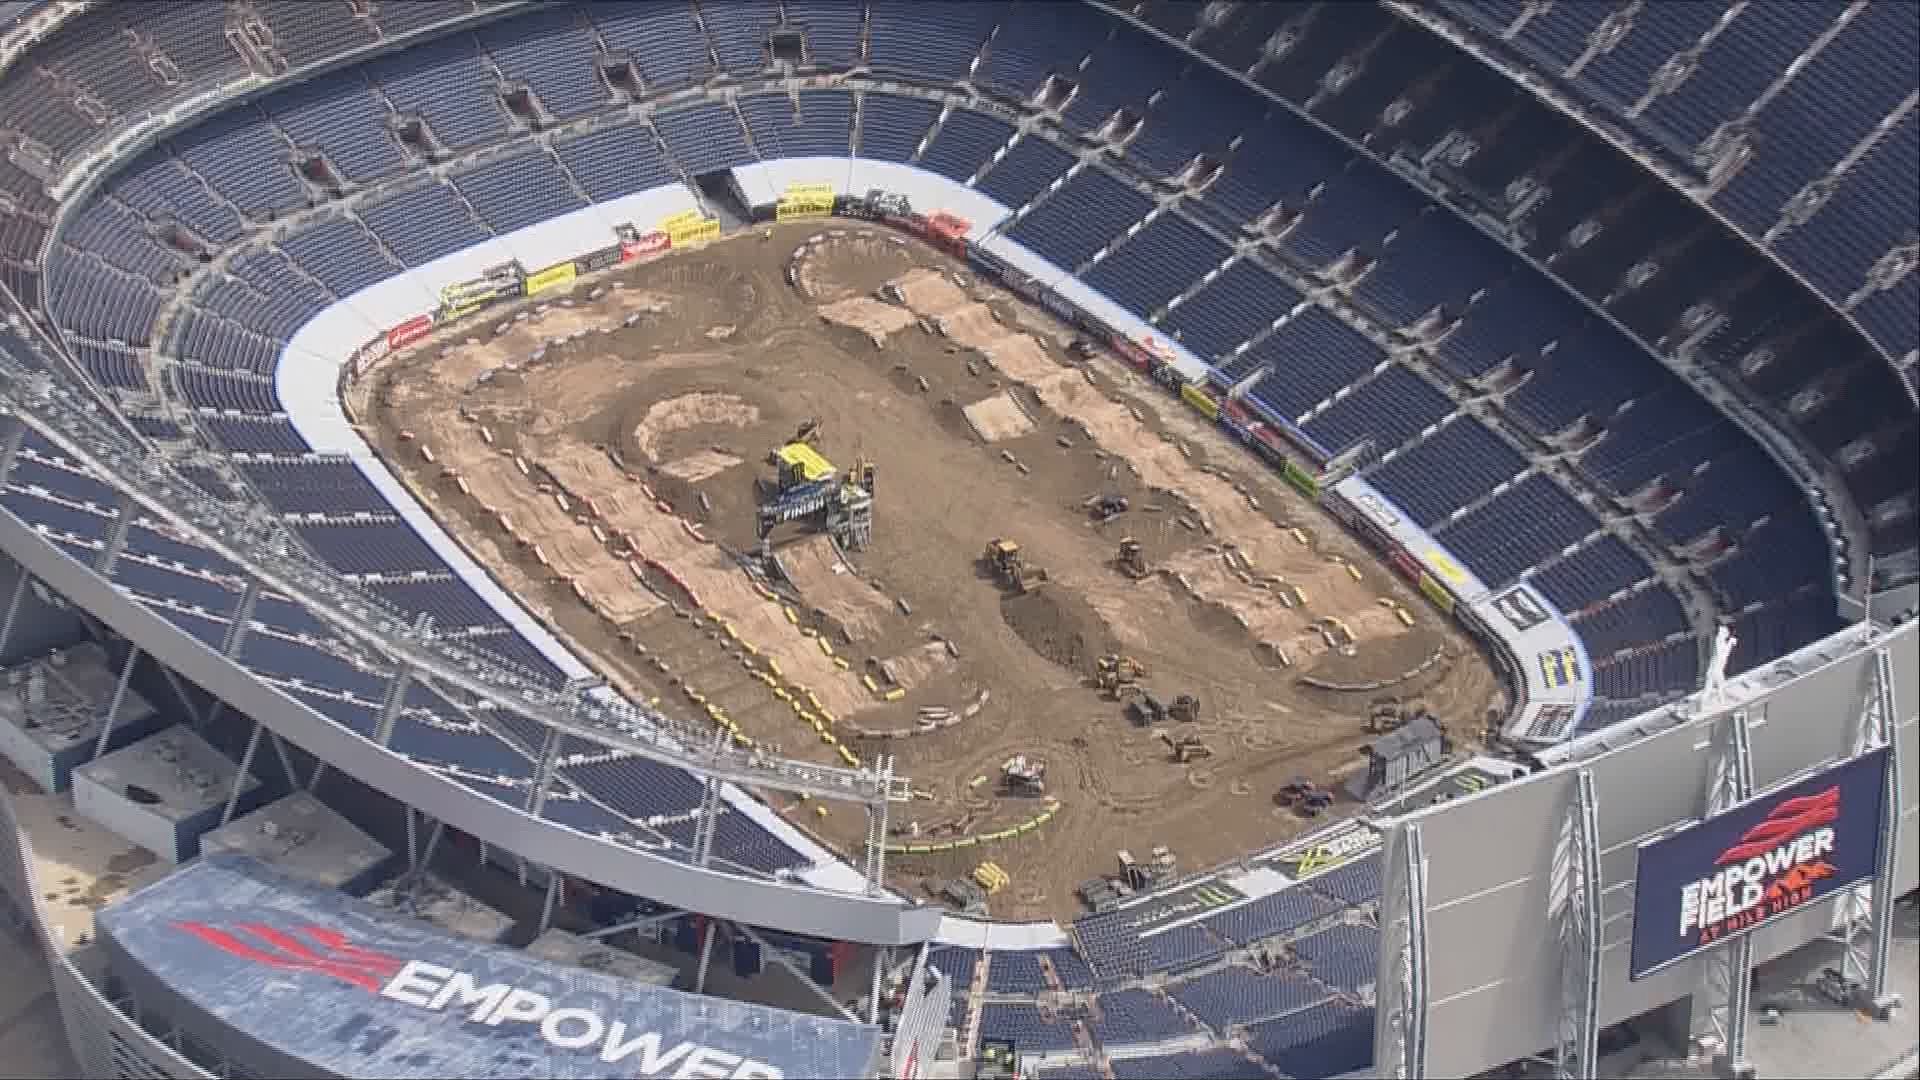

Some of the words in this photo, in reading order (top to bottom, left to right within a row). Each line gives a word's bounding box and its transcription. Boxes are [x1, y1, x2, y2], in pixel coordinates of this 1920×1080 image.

[782, 495, 825, 521] FINISH
[1681, 827, 1836, 910] EMPOWER
[1680, 882, 1765, 937] FIELD
[1700, 924, 1721, 944] AT
[1726, 905, 1765, 930] MILE
[1770, 883, 1812, 913] HIGH
